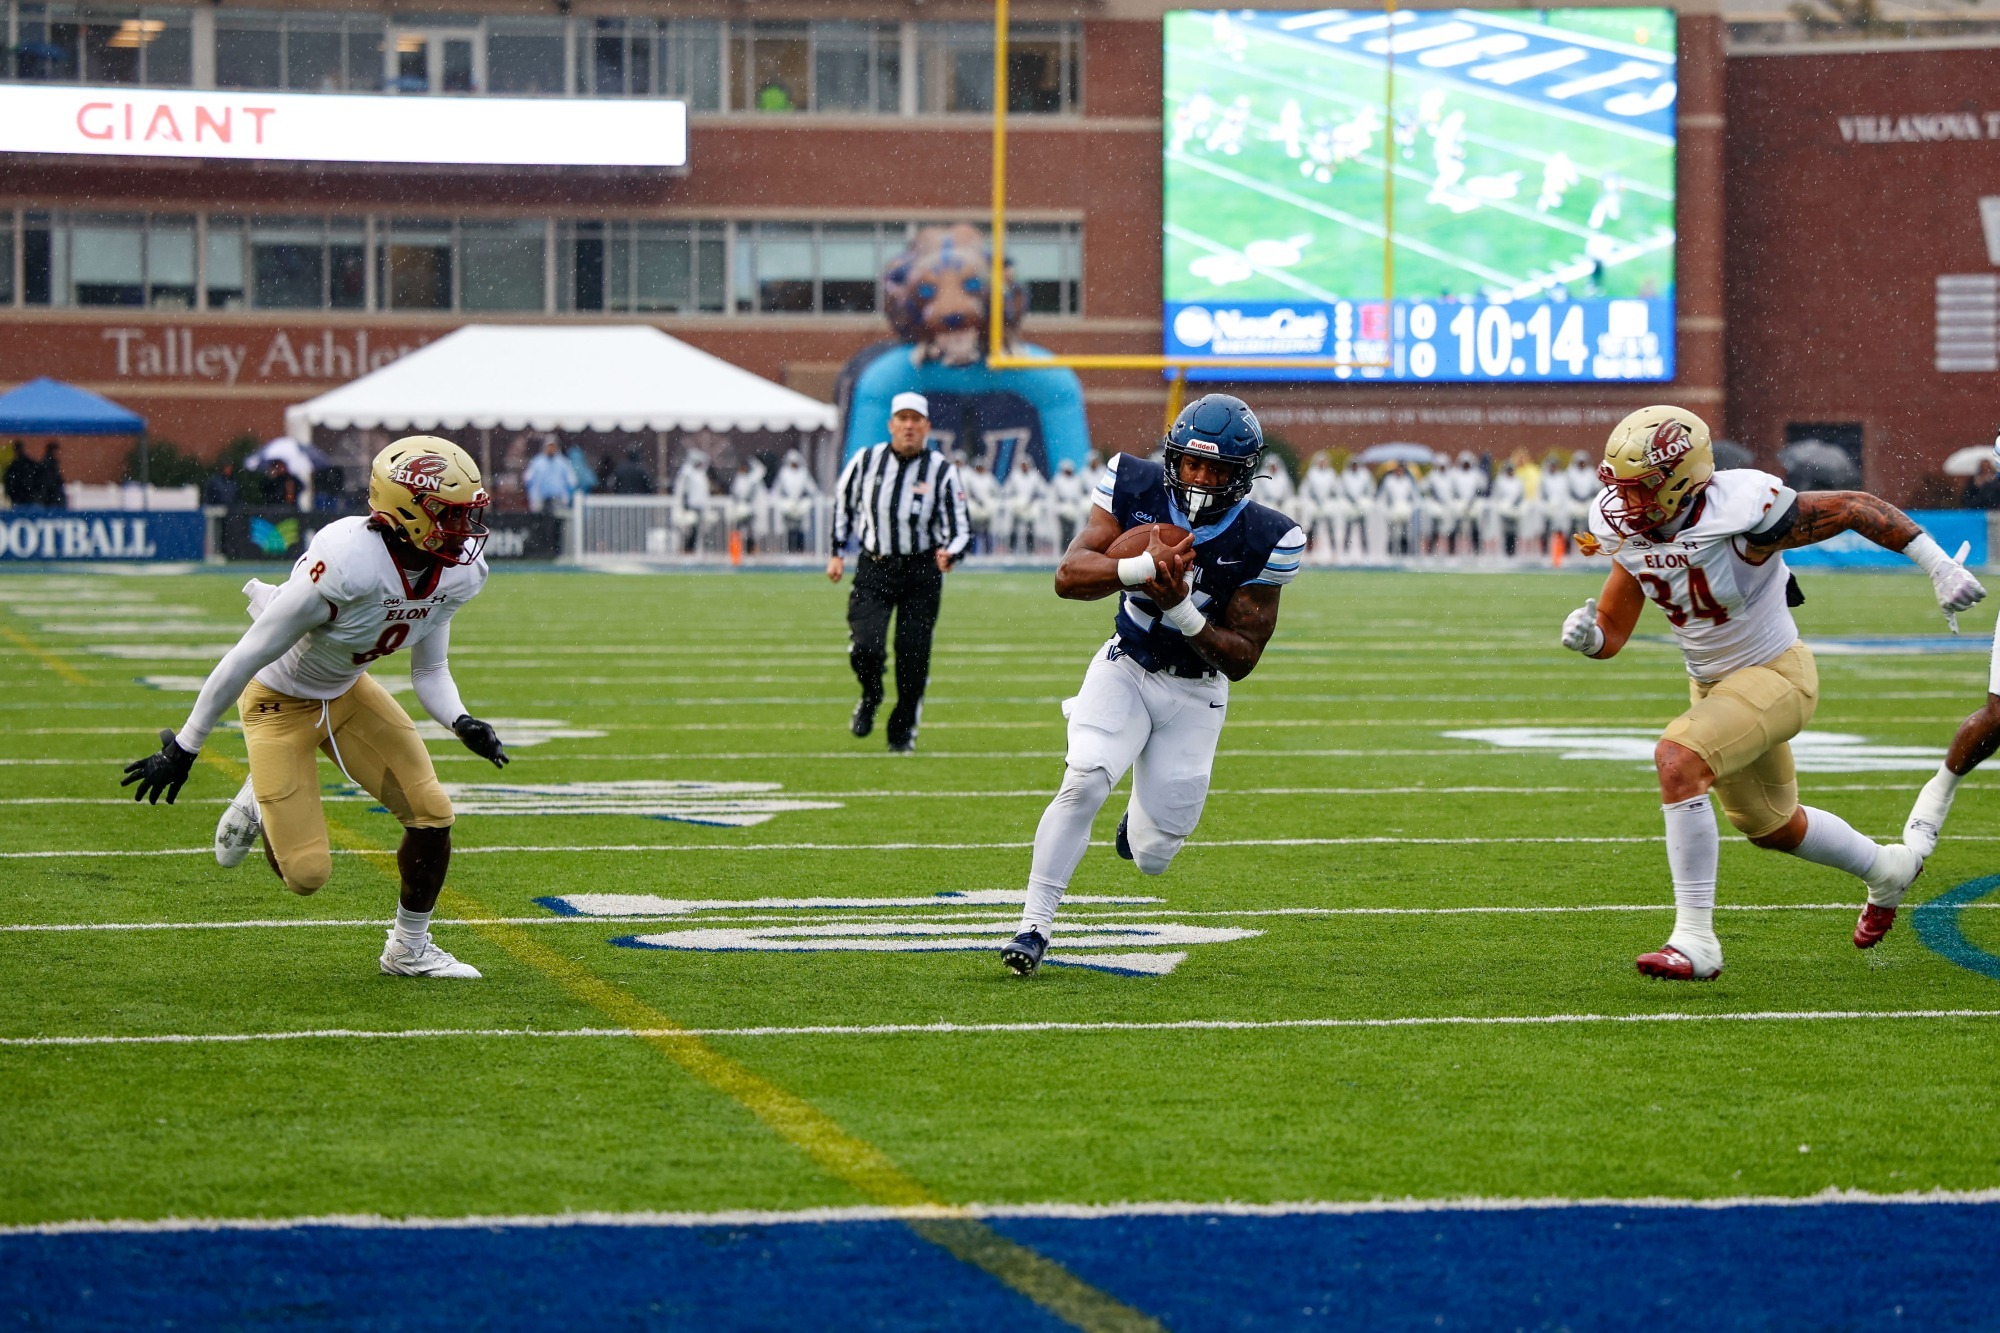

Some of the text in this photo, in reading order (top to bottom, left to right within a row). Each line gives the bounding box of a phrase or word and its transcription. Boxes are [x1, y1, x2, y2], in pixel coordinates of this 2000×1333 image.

[76, 102, 277, 144] GIANT
[1838, 113, 1982, 143] VILLANOVA
[1410, 304, 1437, 340] 0
[1450, 304, 1589, 376] 10:14
[102, 329, 247, 385] Talley
[1410, 342, 1437, 378] 0
[1190, 440, 1216, 452] Riddell
[1646, 436, 1691, 466] ELON
[395, 468, 441, 491] ELON
[1135, 511, 1153, 523] CAA
[310, 560, 326, 584] 8
[1643, 554, 1690, 569] ELON
[382, 607, 432, 621] ELON
[352, 622, 411, 665] 8
